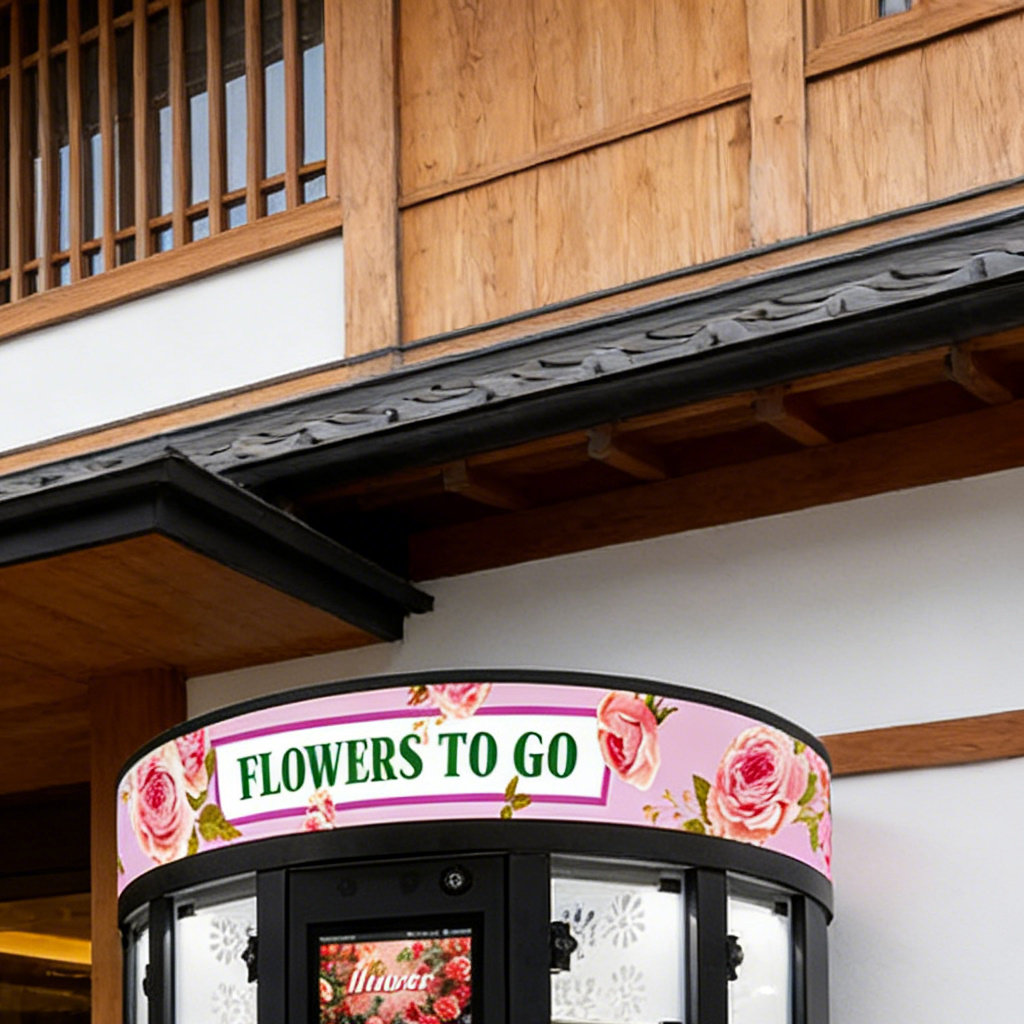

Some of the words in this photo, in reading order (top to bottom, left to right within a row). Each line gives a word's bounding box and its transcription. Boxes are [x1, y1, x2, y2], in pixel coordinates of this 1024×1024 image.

[237, 733, 424, 800] FLOWERS
[438, 731, 498, 778] TO
[514, 731, 577, 778] GO
